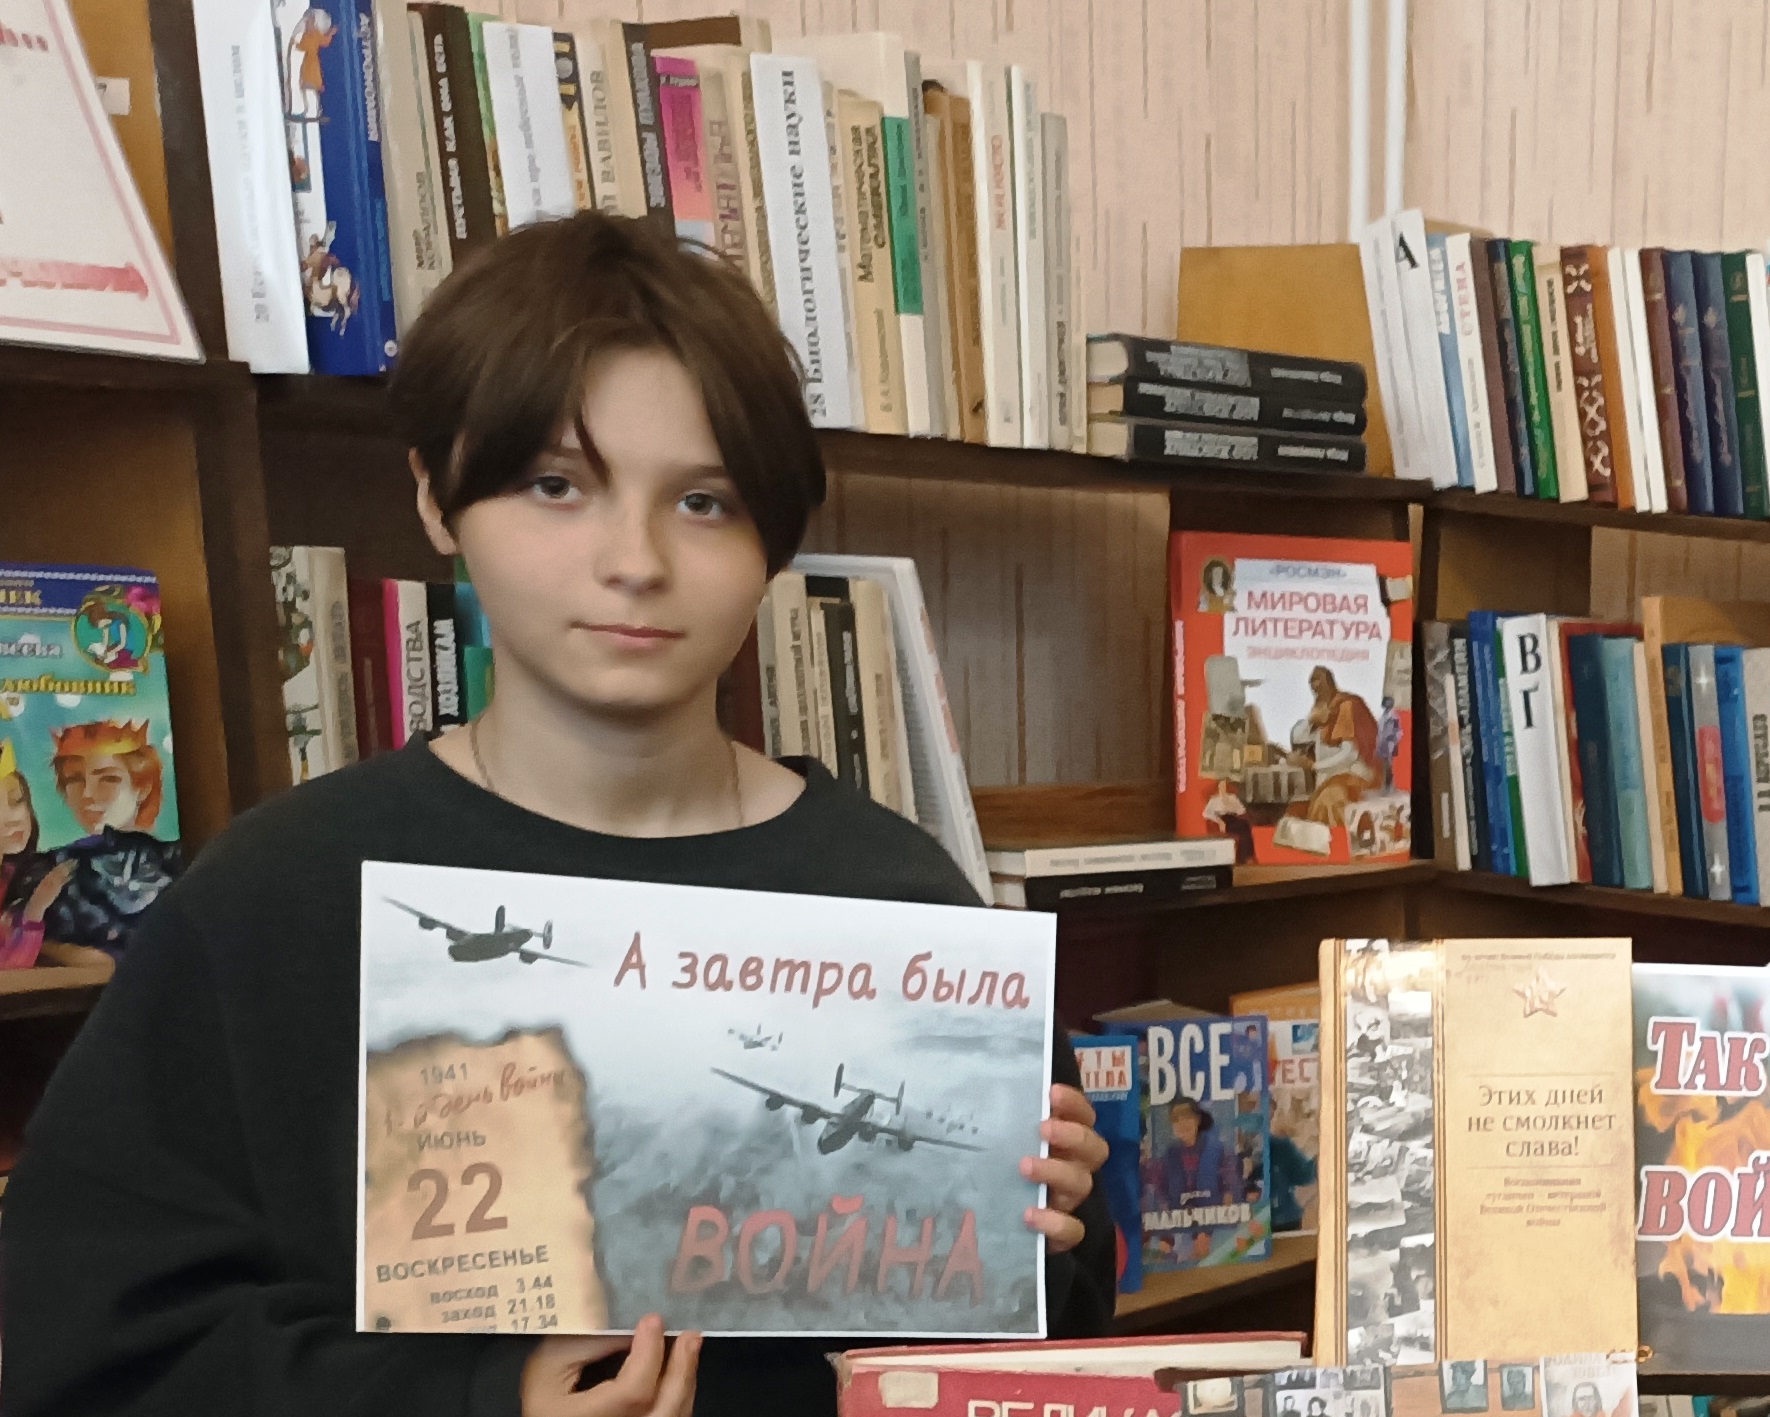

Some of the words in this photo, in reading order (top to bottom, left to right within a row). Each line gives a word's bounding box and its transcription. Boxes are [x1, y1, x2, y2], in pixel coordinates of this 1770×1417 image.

[780, 70, 804, 157] науки
[1396, 231, 1420, 271] А
[790, 164, 823, 383] Биологические
[1247, 591, 1368, 614] МИРОВАЯ
[1232, 617, 1382, 641] ЛИТЕРАТУРА
[1517, 633, 1541, 674] В
[1521, 682, 1541, 730] Г
[613, 930, 647, 990] А
[672, 950, 877, 1009] завтра
[903, 950, 1030, 1010] была
[420, 1062, 468, 1085] 1941
[1147, 1021, 1237, 1106] ВСЕ
[1478, 1084, 1537, 1107] Этих
[1545, 1082, 1605, 1108] дней
[1468, 1112, 1496, 1133] не
[1502, 1112, 1617, 1133] смолкнет
[1505, 1135, 1580, 1158] слава!
[406, 1161, 508, 1241] 22
[376, 1244, 549, 1283] ВОСКРЕСЕНЬЕ
[672, 1193, 986, 1306] ВОЙНА
